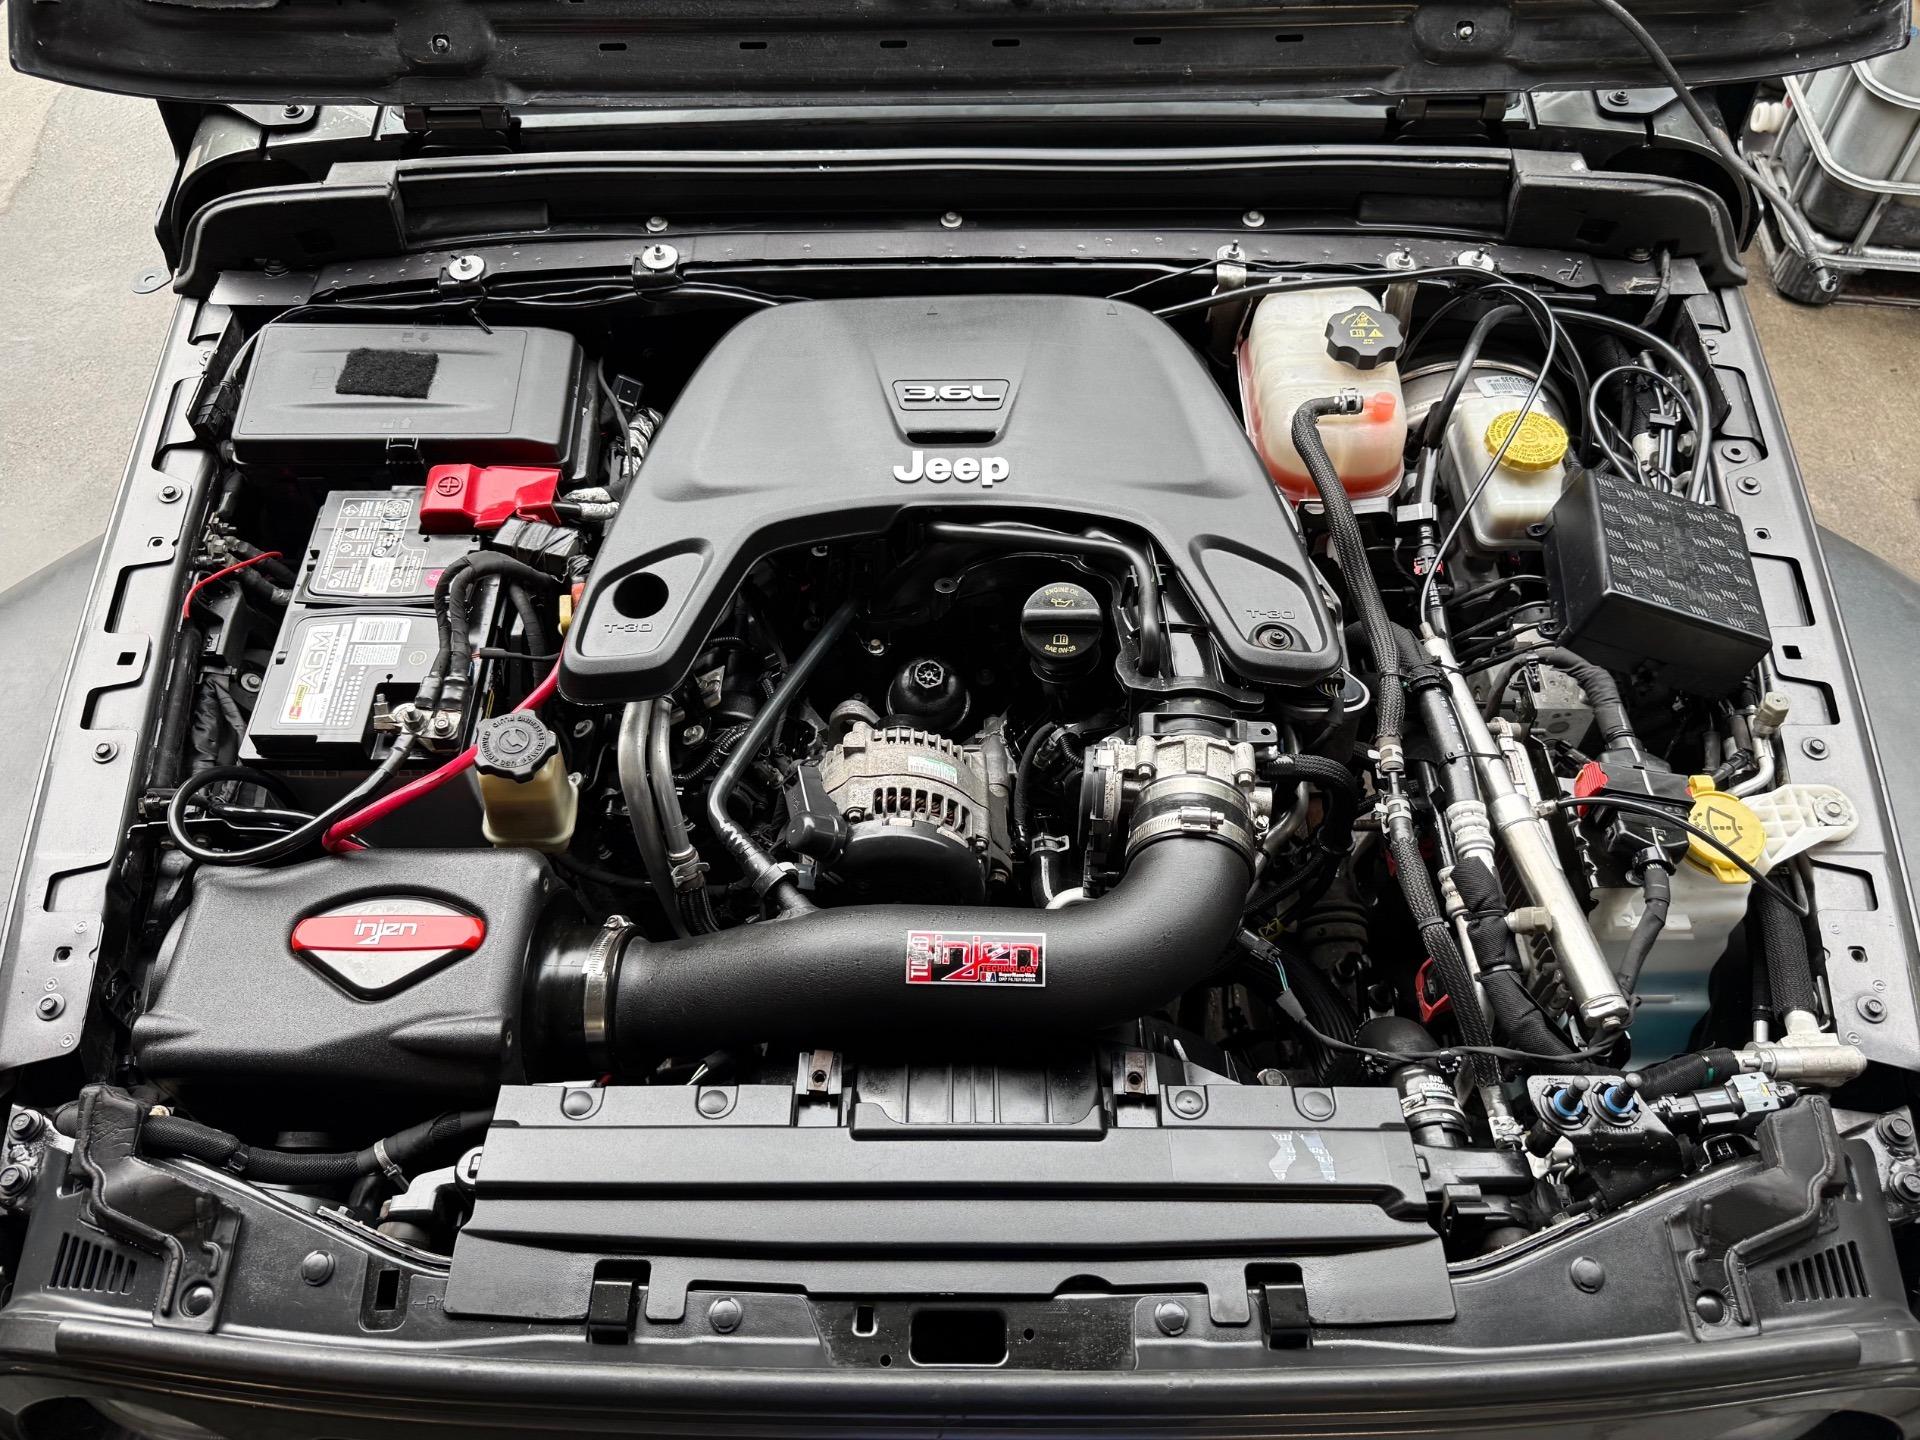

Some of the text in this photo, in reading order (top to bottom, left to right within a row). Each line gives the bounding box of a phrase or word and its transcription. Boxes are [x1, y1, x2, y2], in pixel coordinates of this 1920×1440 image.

[904, 385, 1000, 402] 3.6L
[893, 450, 1009, 488] Jeep
[1045, 586, 1079, 597] ENGINE OIL
[1246, 609, 1295, 620] T-30
[604, 623, 653, 634] T-30
[1044, 644, 1076, 653] SAE 0W-20
[301, 631, 333, 689] AGM
[353, 919, 418, 945] injen
[934, 935, 1039, 981] injen
[981, 965, 1038, 973] TECHNOLOGY
